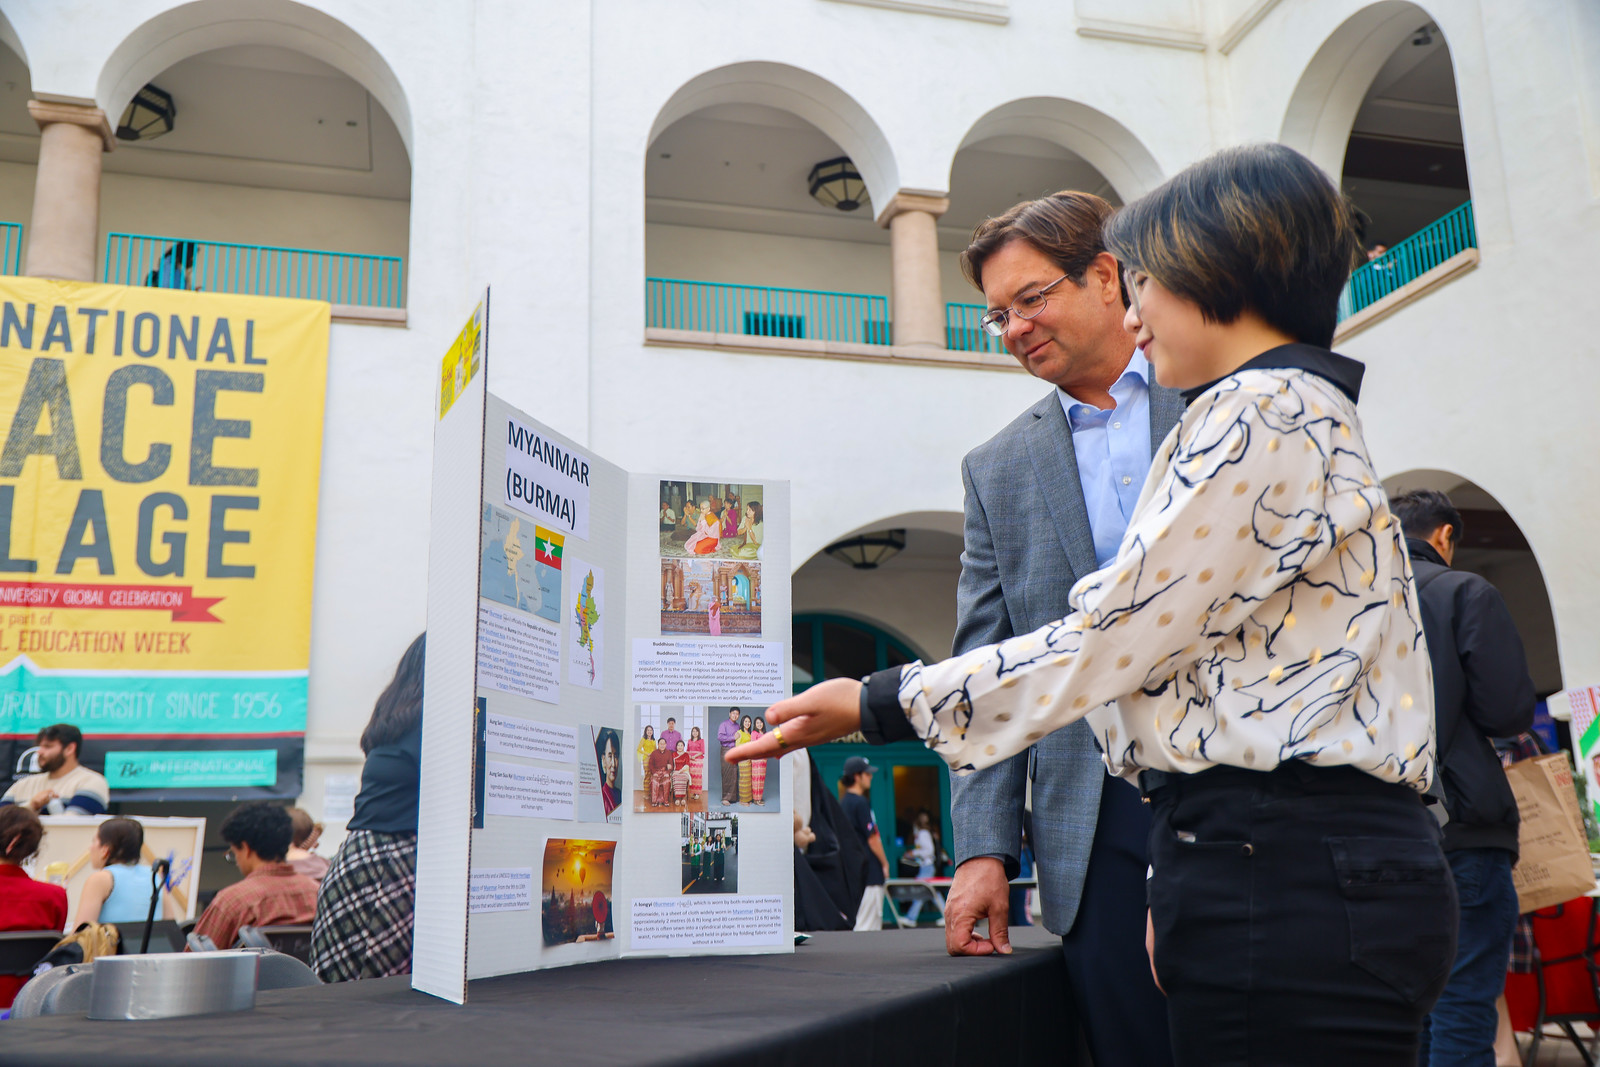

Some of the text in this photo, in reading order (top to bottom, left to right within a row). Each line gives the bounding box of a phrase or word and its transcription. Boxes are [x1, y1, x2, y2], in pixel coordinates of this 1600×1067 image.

[0, 302, 267, 365] NATIONAL
[0, 357, 265, 487] ACE
[508, 421, 589, 487] MYANMAR
[507, 468, 576, 530] (BURMA)
[0, 485, 259, 578] LAGE
[9, 613, 35, 628] part
[40, 612, 53, 625] of
[63, 590, 104, 605] GLOBAL
[109, 591, 183, 607] CELEBRATION
[18, 630, 124, 654] EDUCATION
[135, 632, 191, 654] WEEK
[56, 692, 154, 719] DIVERSITY
[166, 692, 219, 718] SINCE
[232, 692, 282, 718] 1956
[119, 758, 266, 778] Be INTERNATIONAL
